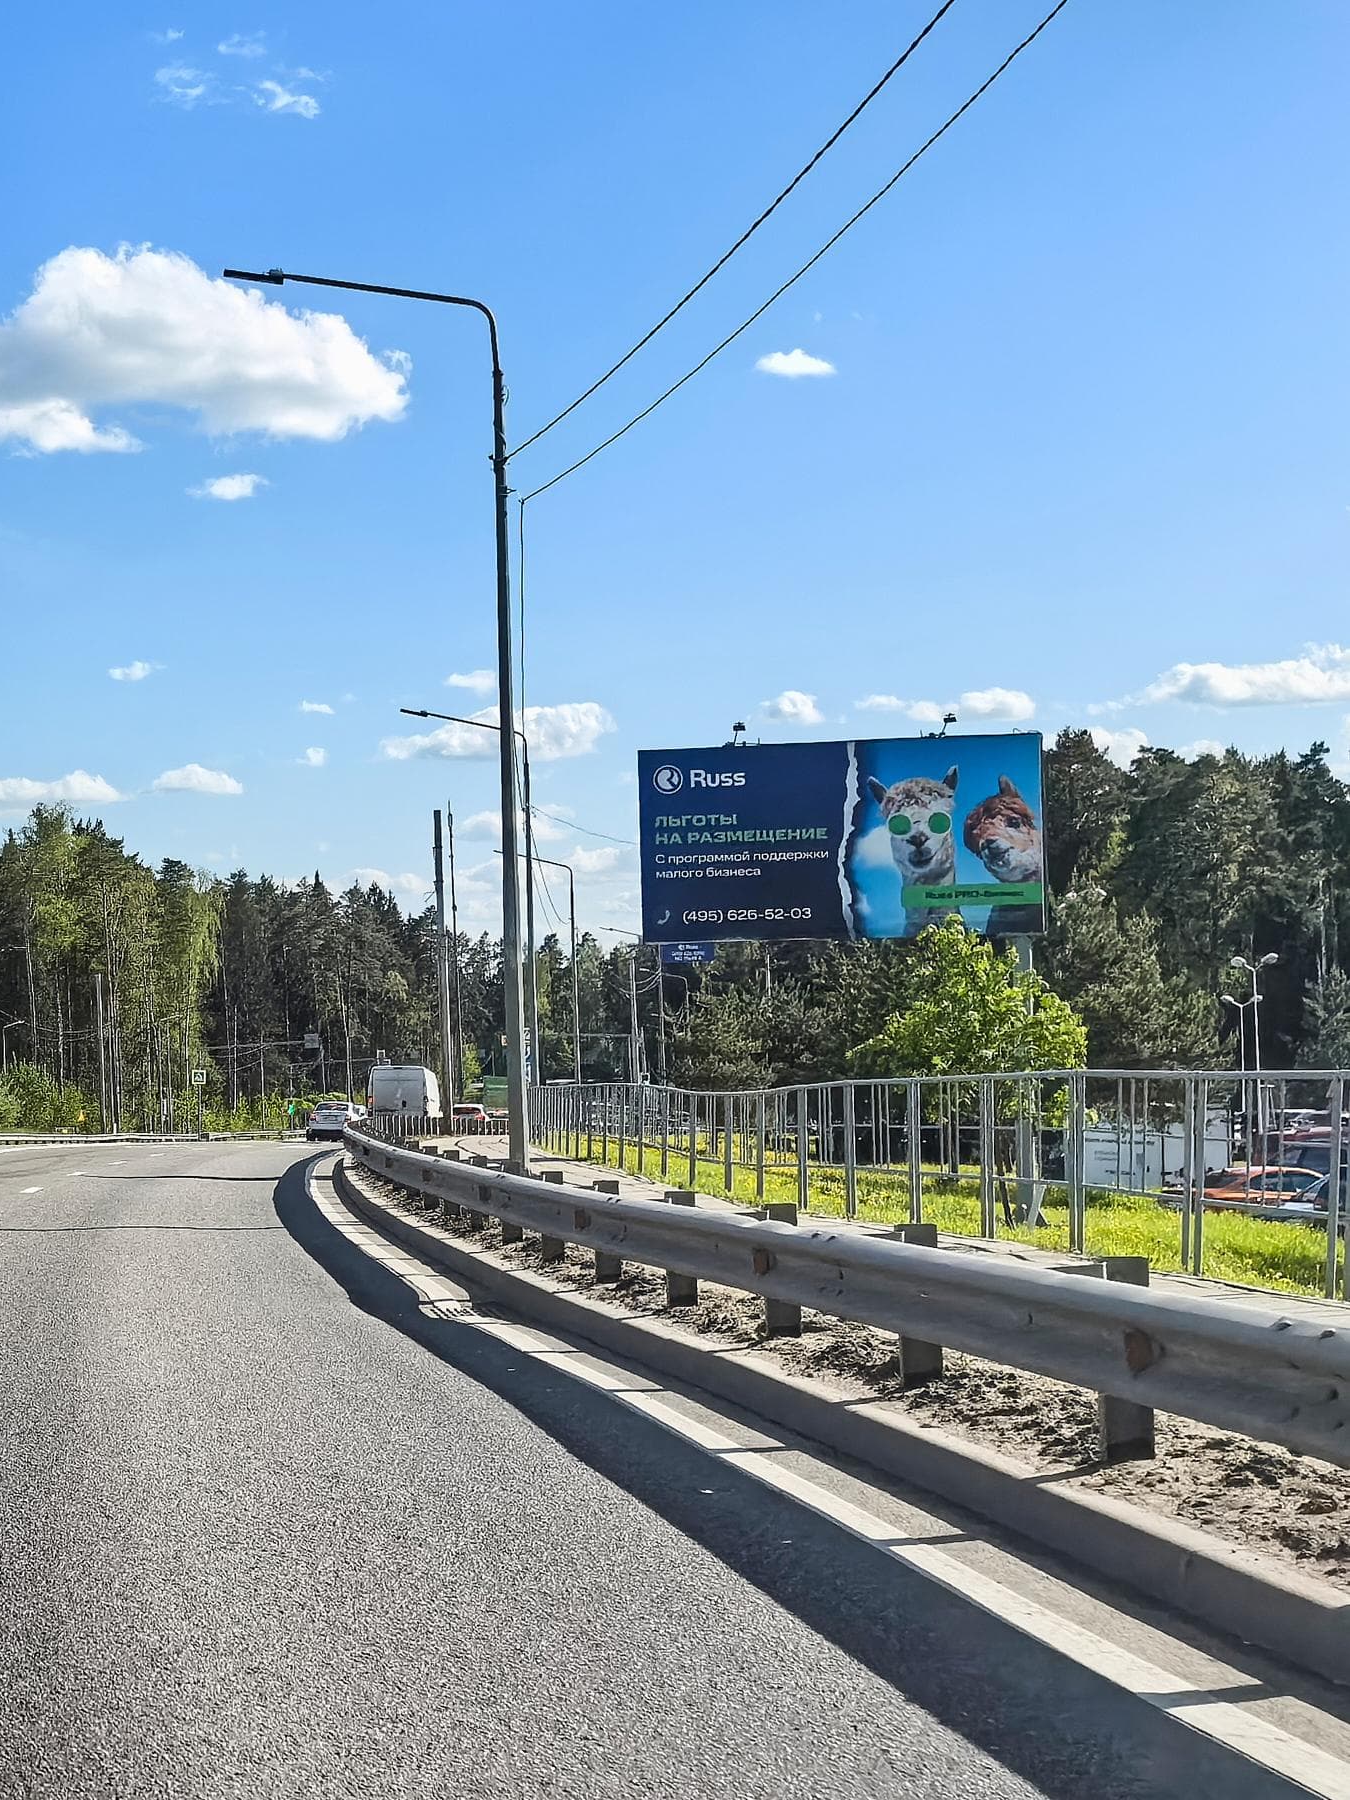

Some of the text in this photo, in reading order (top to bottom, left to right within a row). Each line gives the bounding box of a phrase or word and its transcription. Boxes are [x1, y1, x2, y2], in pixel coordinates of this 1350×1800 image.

[690, 769, 746, 788] Russ
[655, 814, 737, 828] ЛЬГОТЫ
[655, 828, 828, 844] НА РАЗМЕЩЕНИЕ
[655, 850, 828, 864] С программой поддержки
[656, 867, 761, 879] малого бизнеса
[683, 908, 811, 925] (495) 626-52-03
